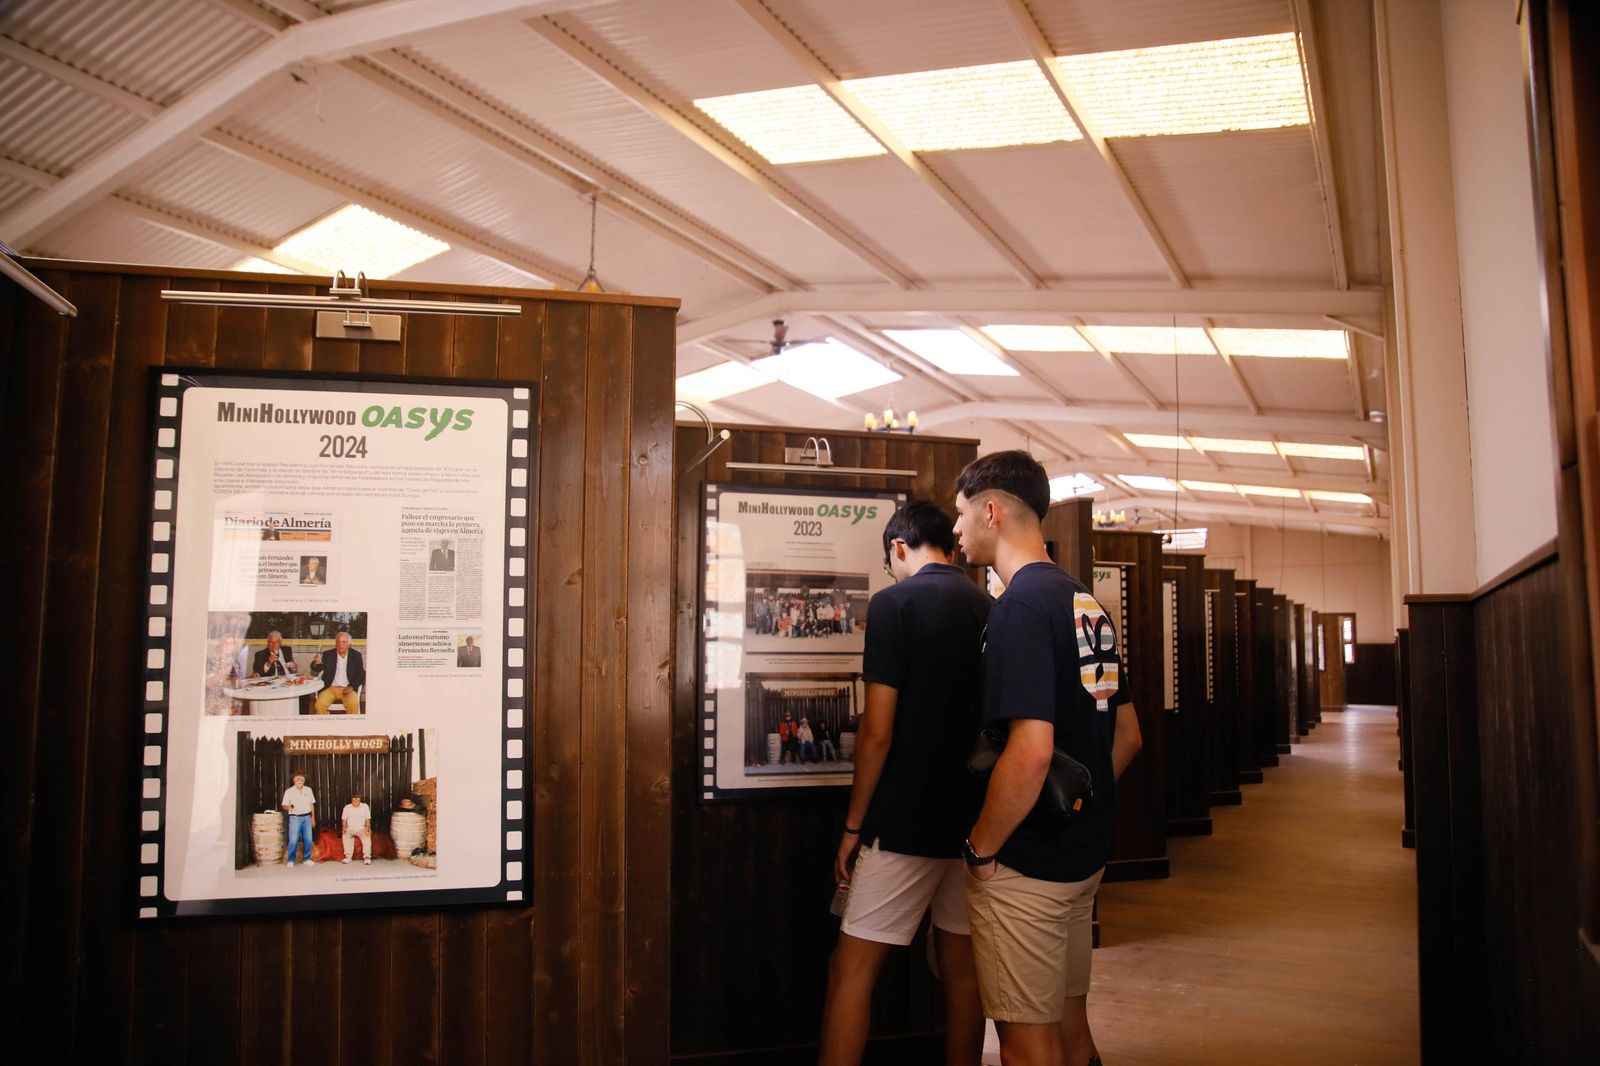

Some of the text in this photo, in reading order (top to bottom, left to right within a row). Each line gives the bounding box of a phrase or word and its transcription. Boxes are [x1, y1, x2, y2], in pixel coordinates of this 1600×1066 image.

[318, 434, 368, 458] 2024
[265, 517, 280, 528] de
[281, 517, 331, 528] Almería
[794, 520, 822, 537] 2023
[289, 739, 383, 750] MINIHOLLYWOOD
